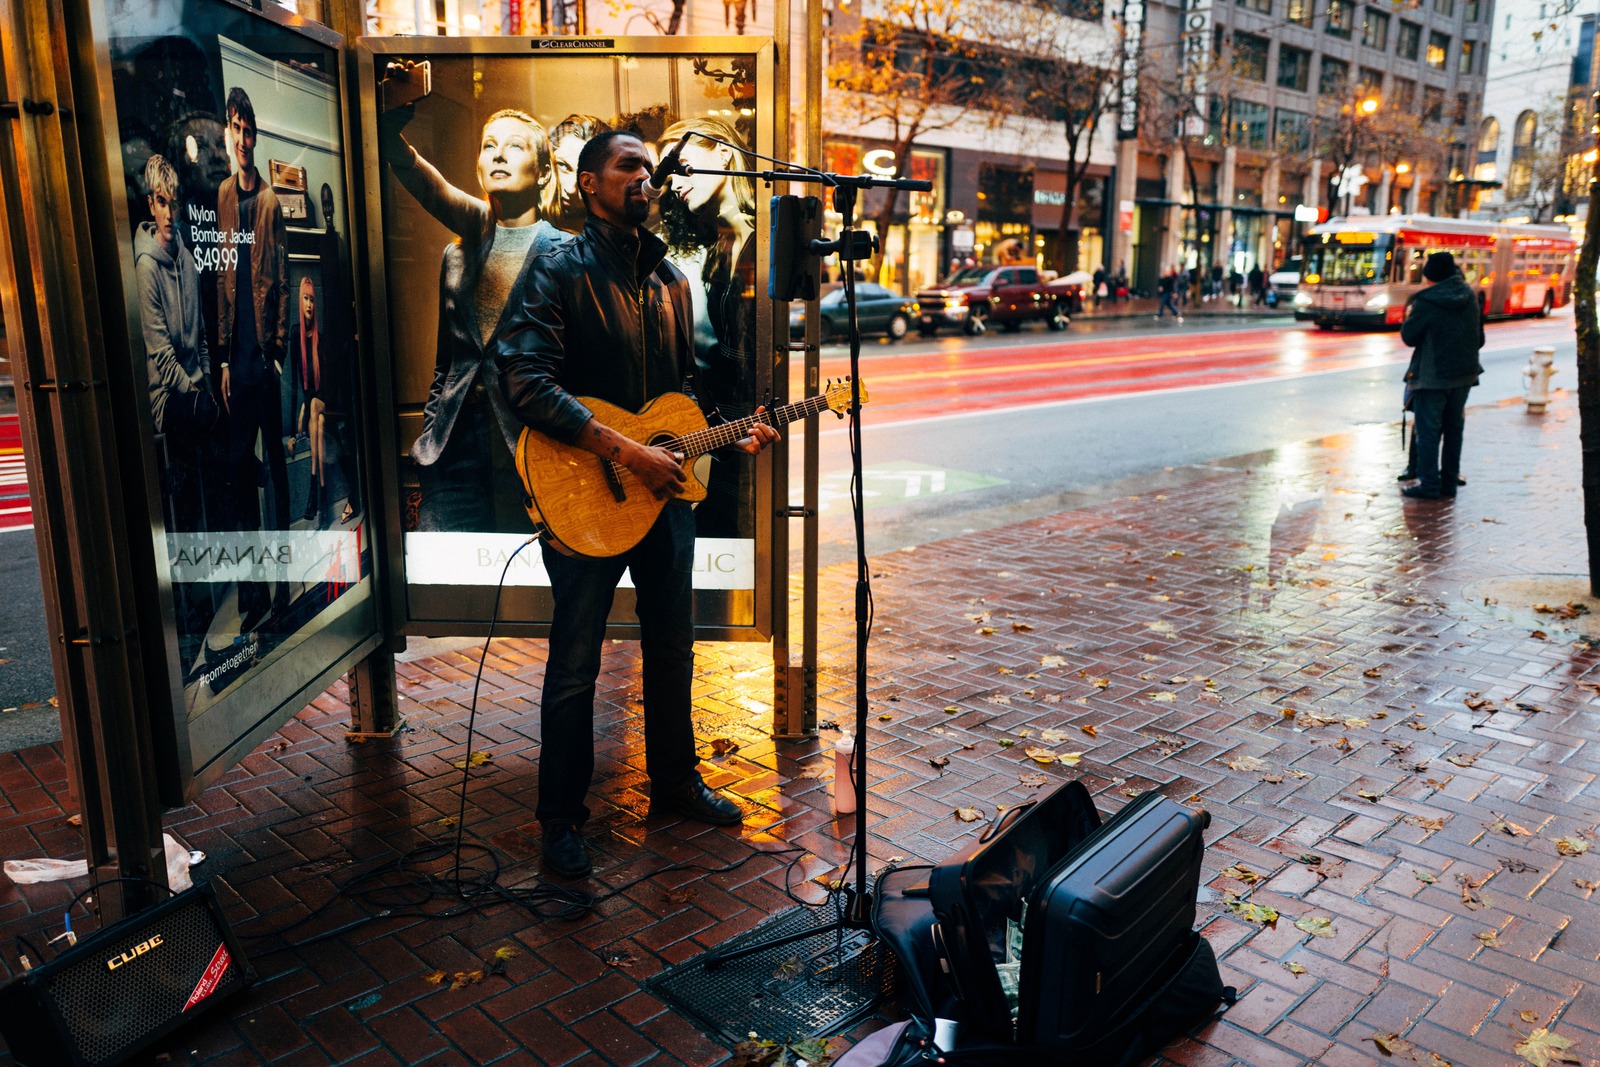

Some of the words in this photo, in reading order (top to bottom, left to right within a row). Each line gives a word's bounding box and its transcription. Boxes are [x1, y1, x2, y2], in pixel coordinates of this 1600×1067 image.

[188, 203, 217, 226] Nylon
[190, 225, 228, 243] Bomber
[228, 227, 257, 245] Jacket
[193, 243, 239, 275] $49.99
[199, 641, 258, 689] #cometogether
[106, 933, 164, 972] CUBE
[190, 978, 208, 1004] Roland
